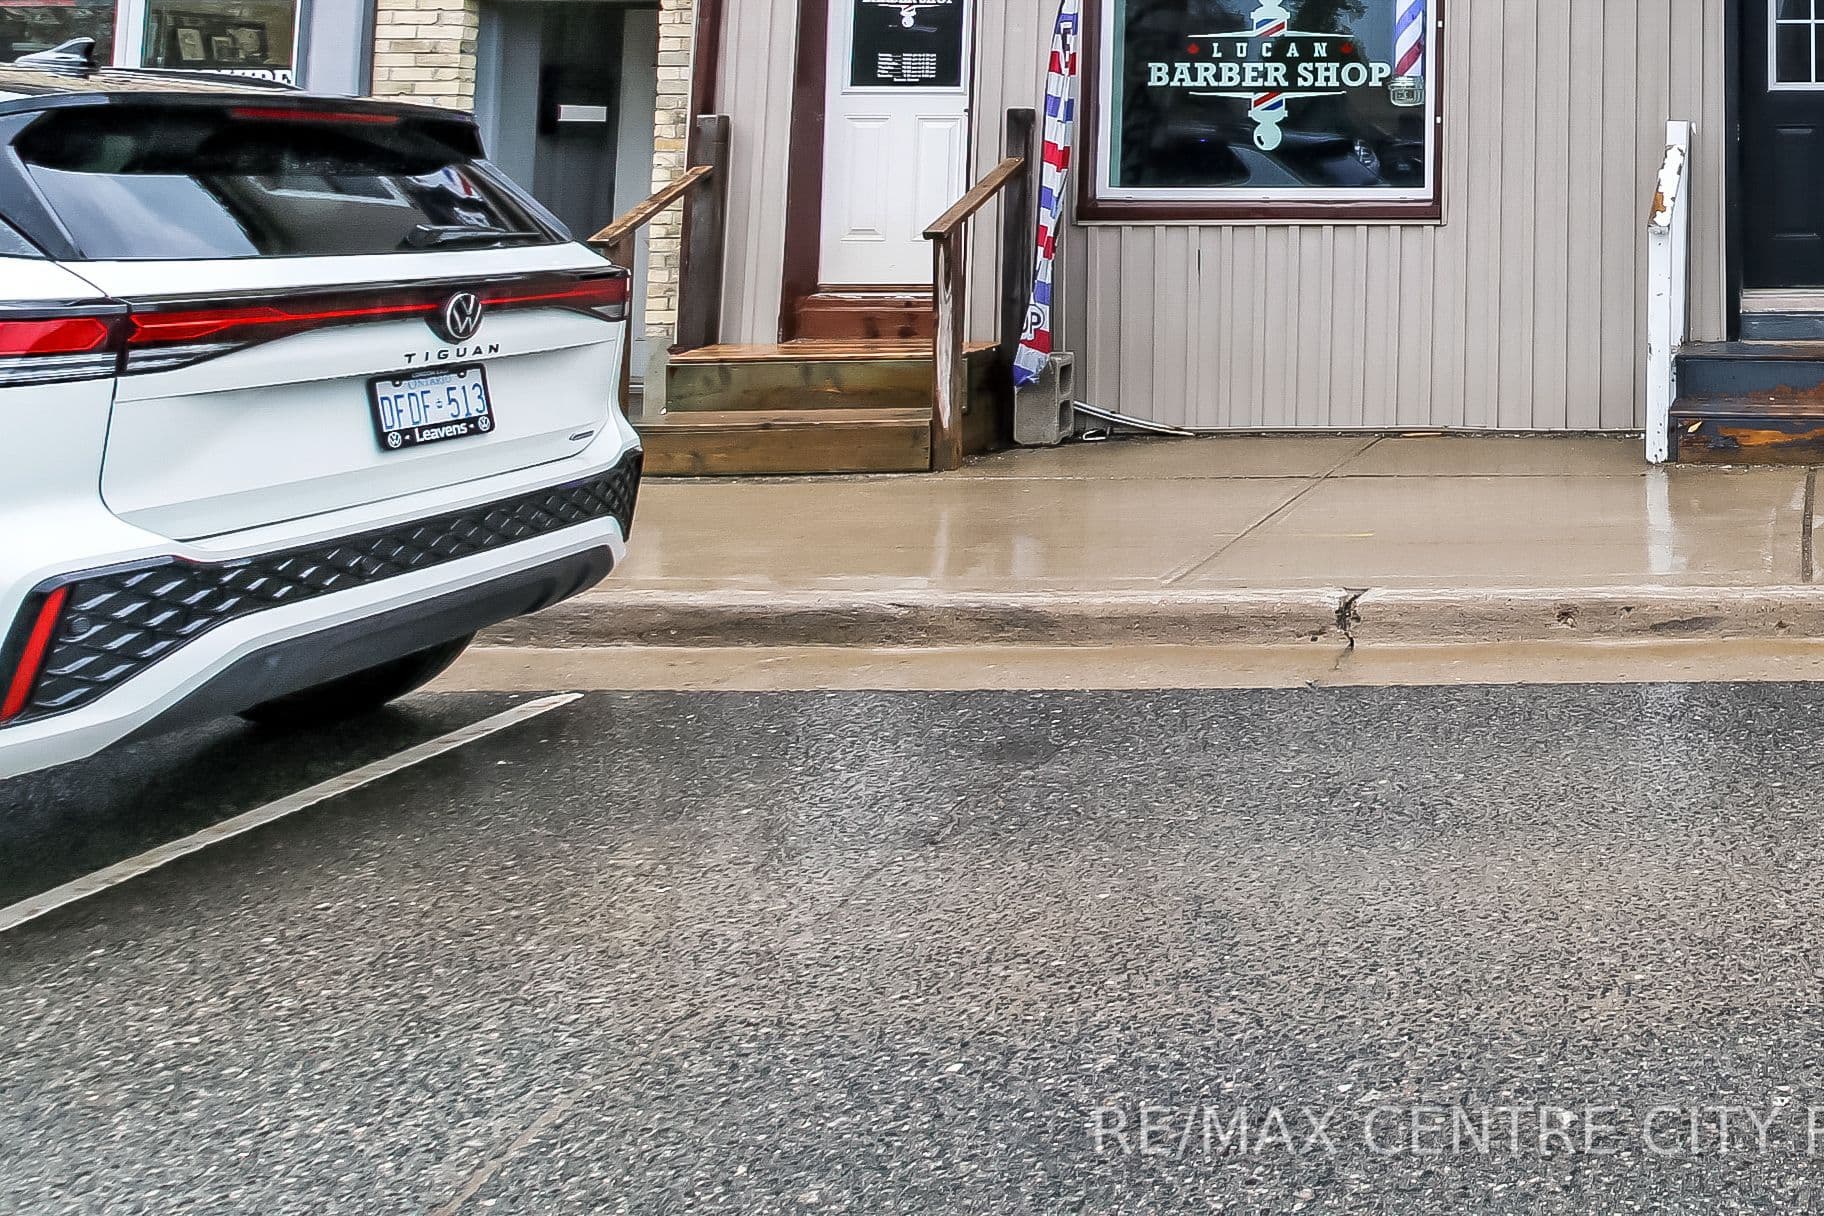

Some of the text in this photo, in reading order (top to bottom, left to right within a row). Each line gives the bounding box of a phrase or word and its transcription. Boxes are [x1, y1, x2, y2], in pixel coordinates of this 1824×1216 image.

[1211, 42, 1328, 58] LUCAN
[1147, 62, 1392, 87] BARBER SHOP
[404, 344, 500, 364] TIGUAN
[414, 423, 468, 443] Leavens
